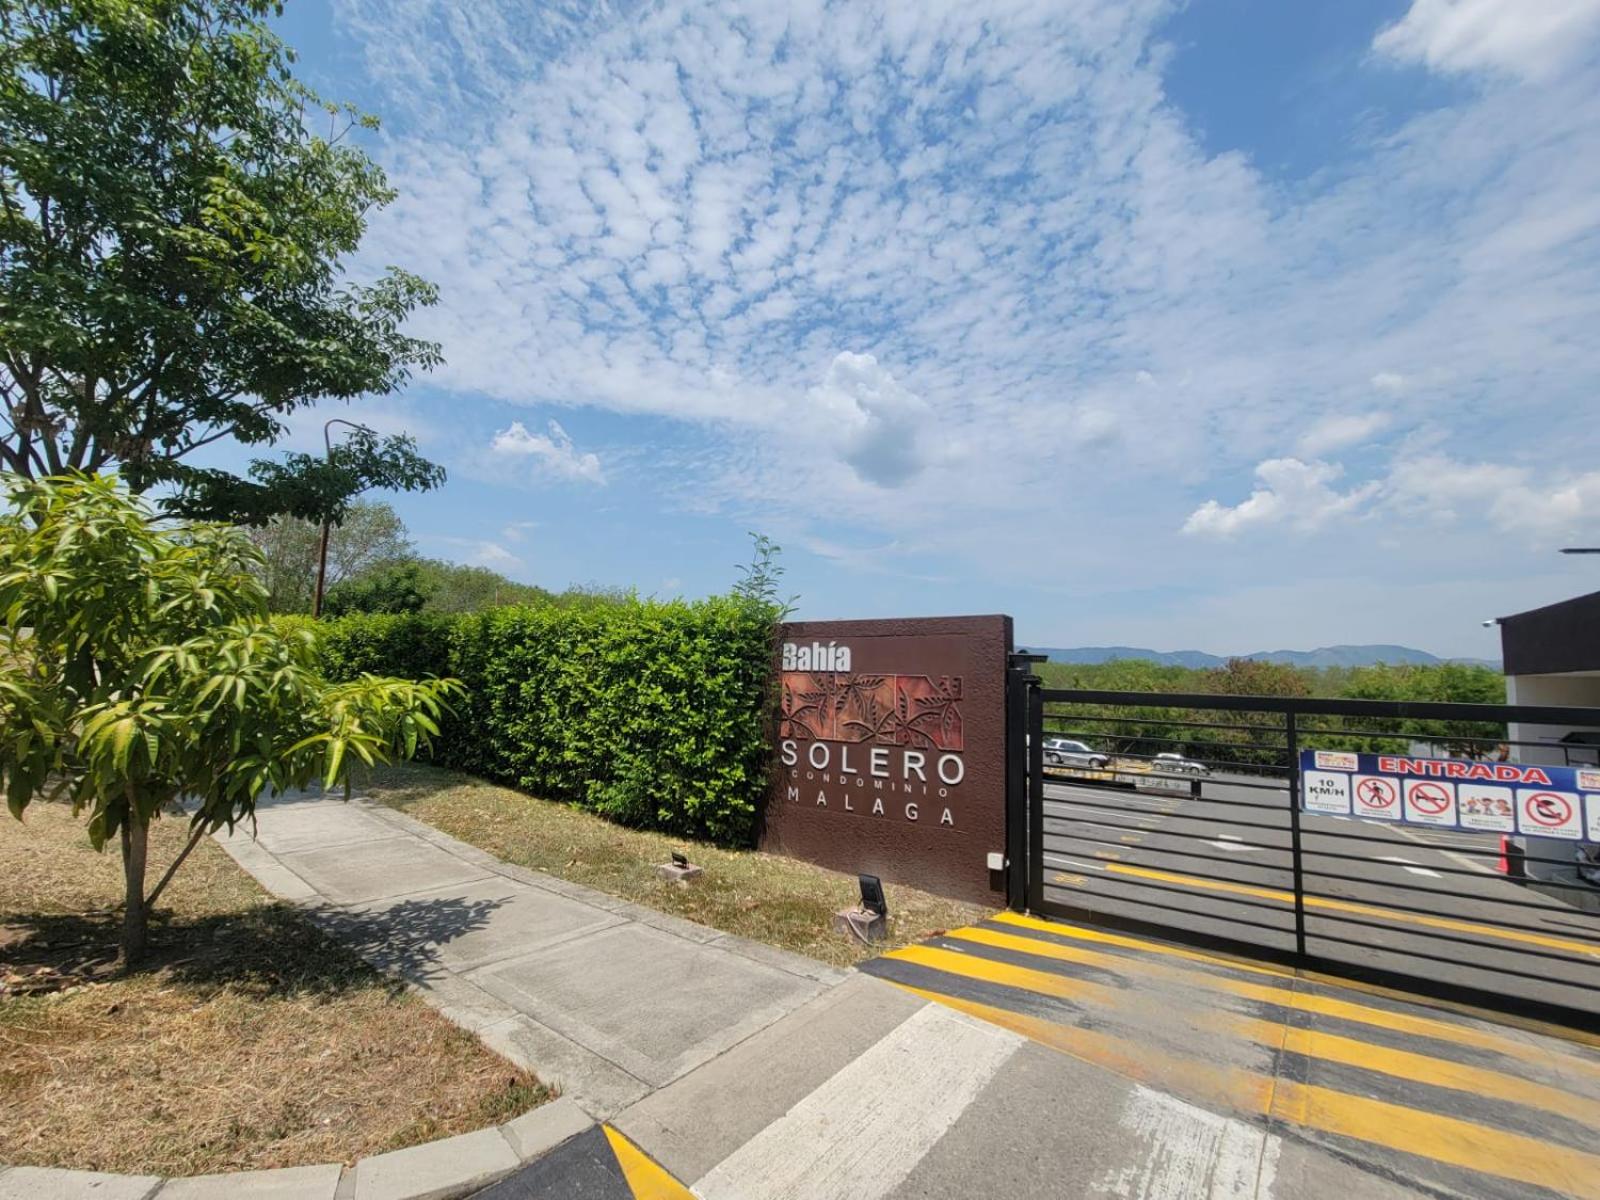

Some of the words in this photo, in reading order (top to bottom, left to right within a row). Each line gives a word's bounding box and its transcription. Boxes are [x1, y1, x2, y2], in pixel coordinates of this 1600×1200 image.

[782, 641, 851, 672] Bahía
[781, 740, 965, 785] SOLERO
[1378, 756, 1552, 785] ENTRADA
[791, 769, 948, 798] CONDOMINIO
[1309, 786, 1345, 796] KM/H
[1319, 779, 1335, 787] 10
[787, 786, 954, 825] MALAGA
